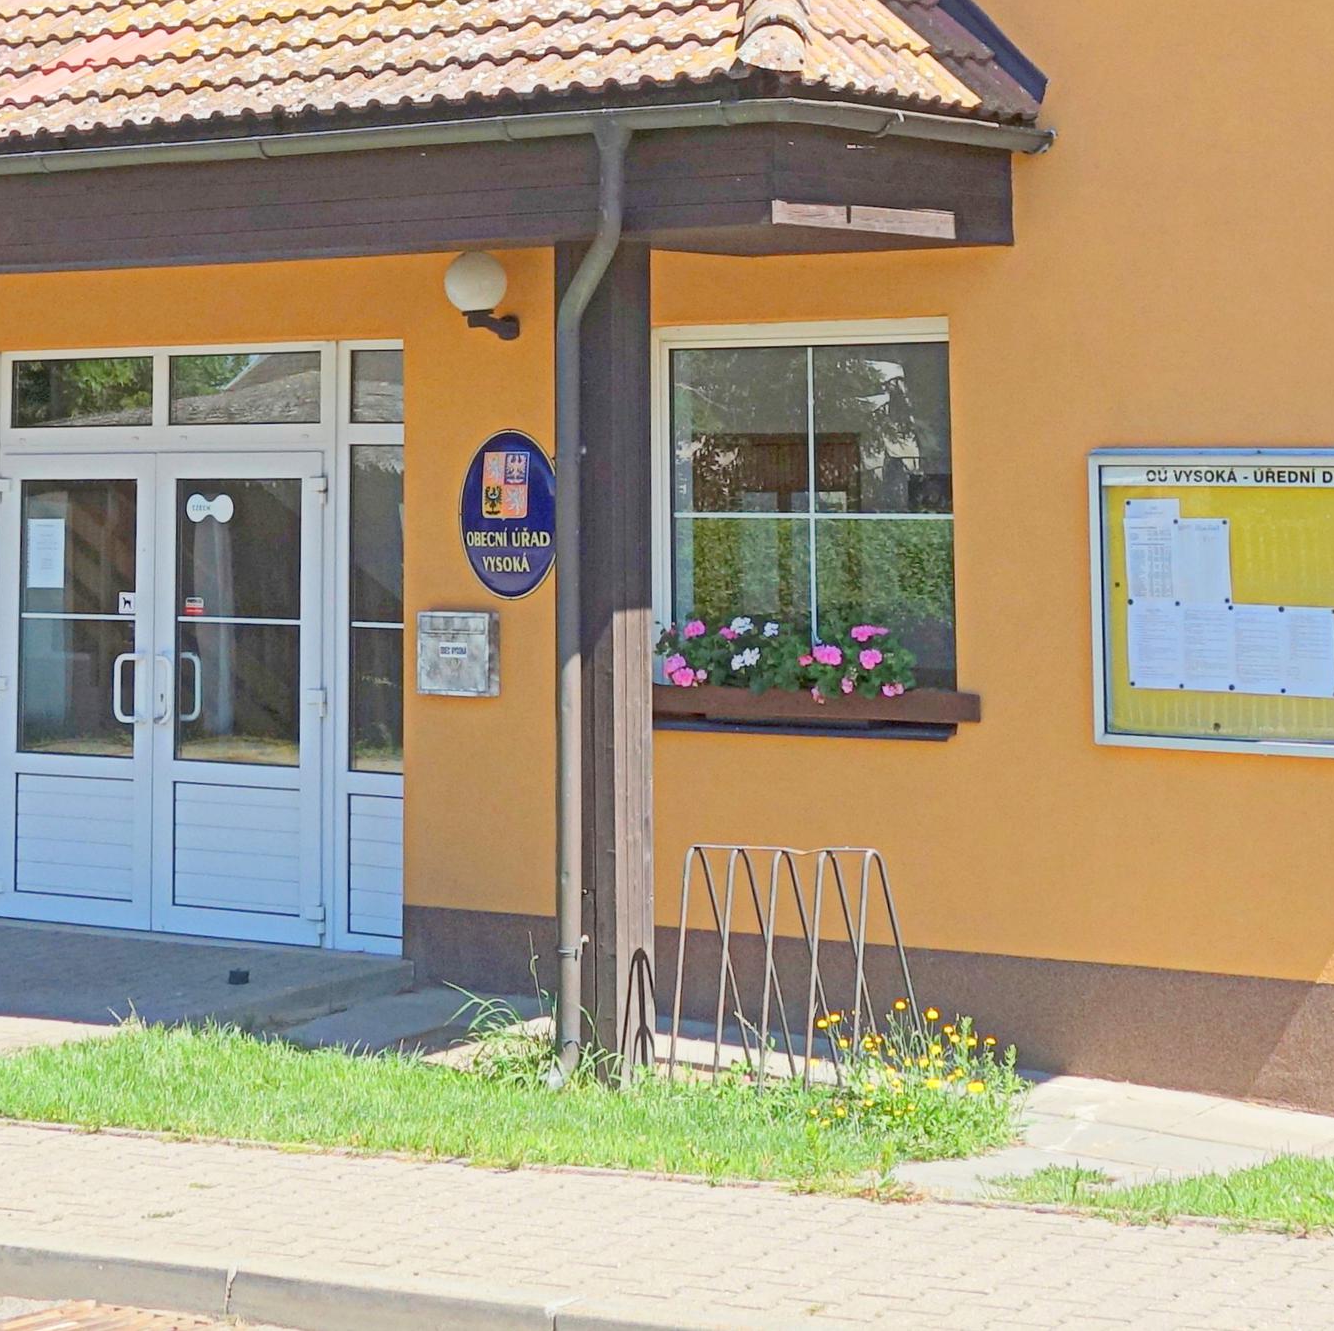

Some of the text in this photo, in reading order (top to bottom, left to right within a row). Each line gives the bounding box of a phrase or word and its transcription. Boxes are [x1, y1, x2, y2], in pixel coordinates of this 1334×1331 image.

[1174, 467, 1237, 483] VYSOKÁ
[1254, 467, 1316, 484] ÚŘEDNÍ
[467, 527, 551, 547] OBECNÍ ÚŘAD
[482, 552, 530, 572] VYSOKÁ
